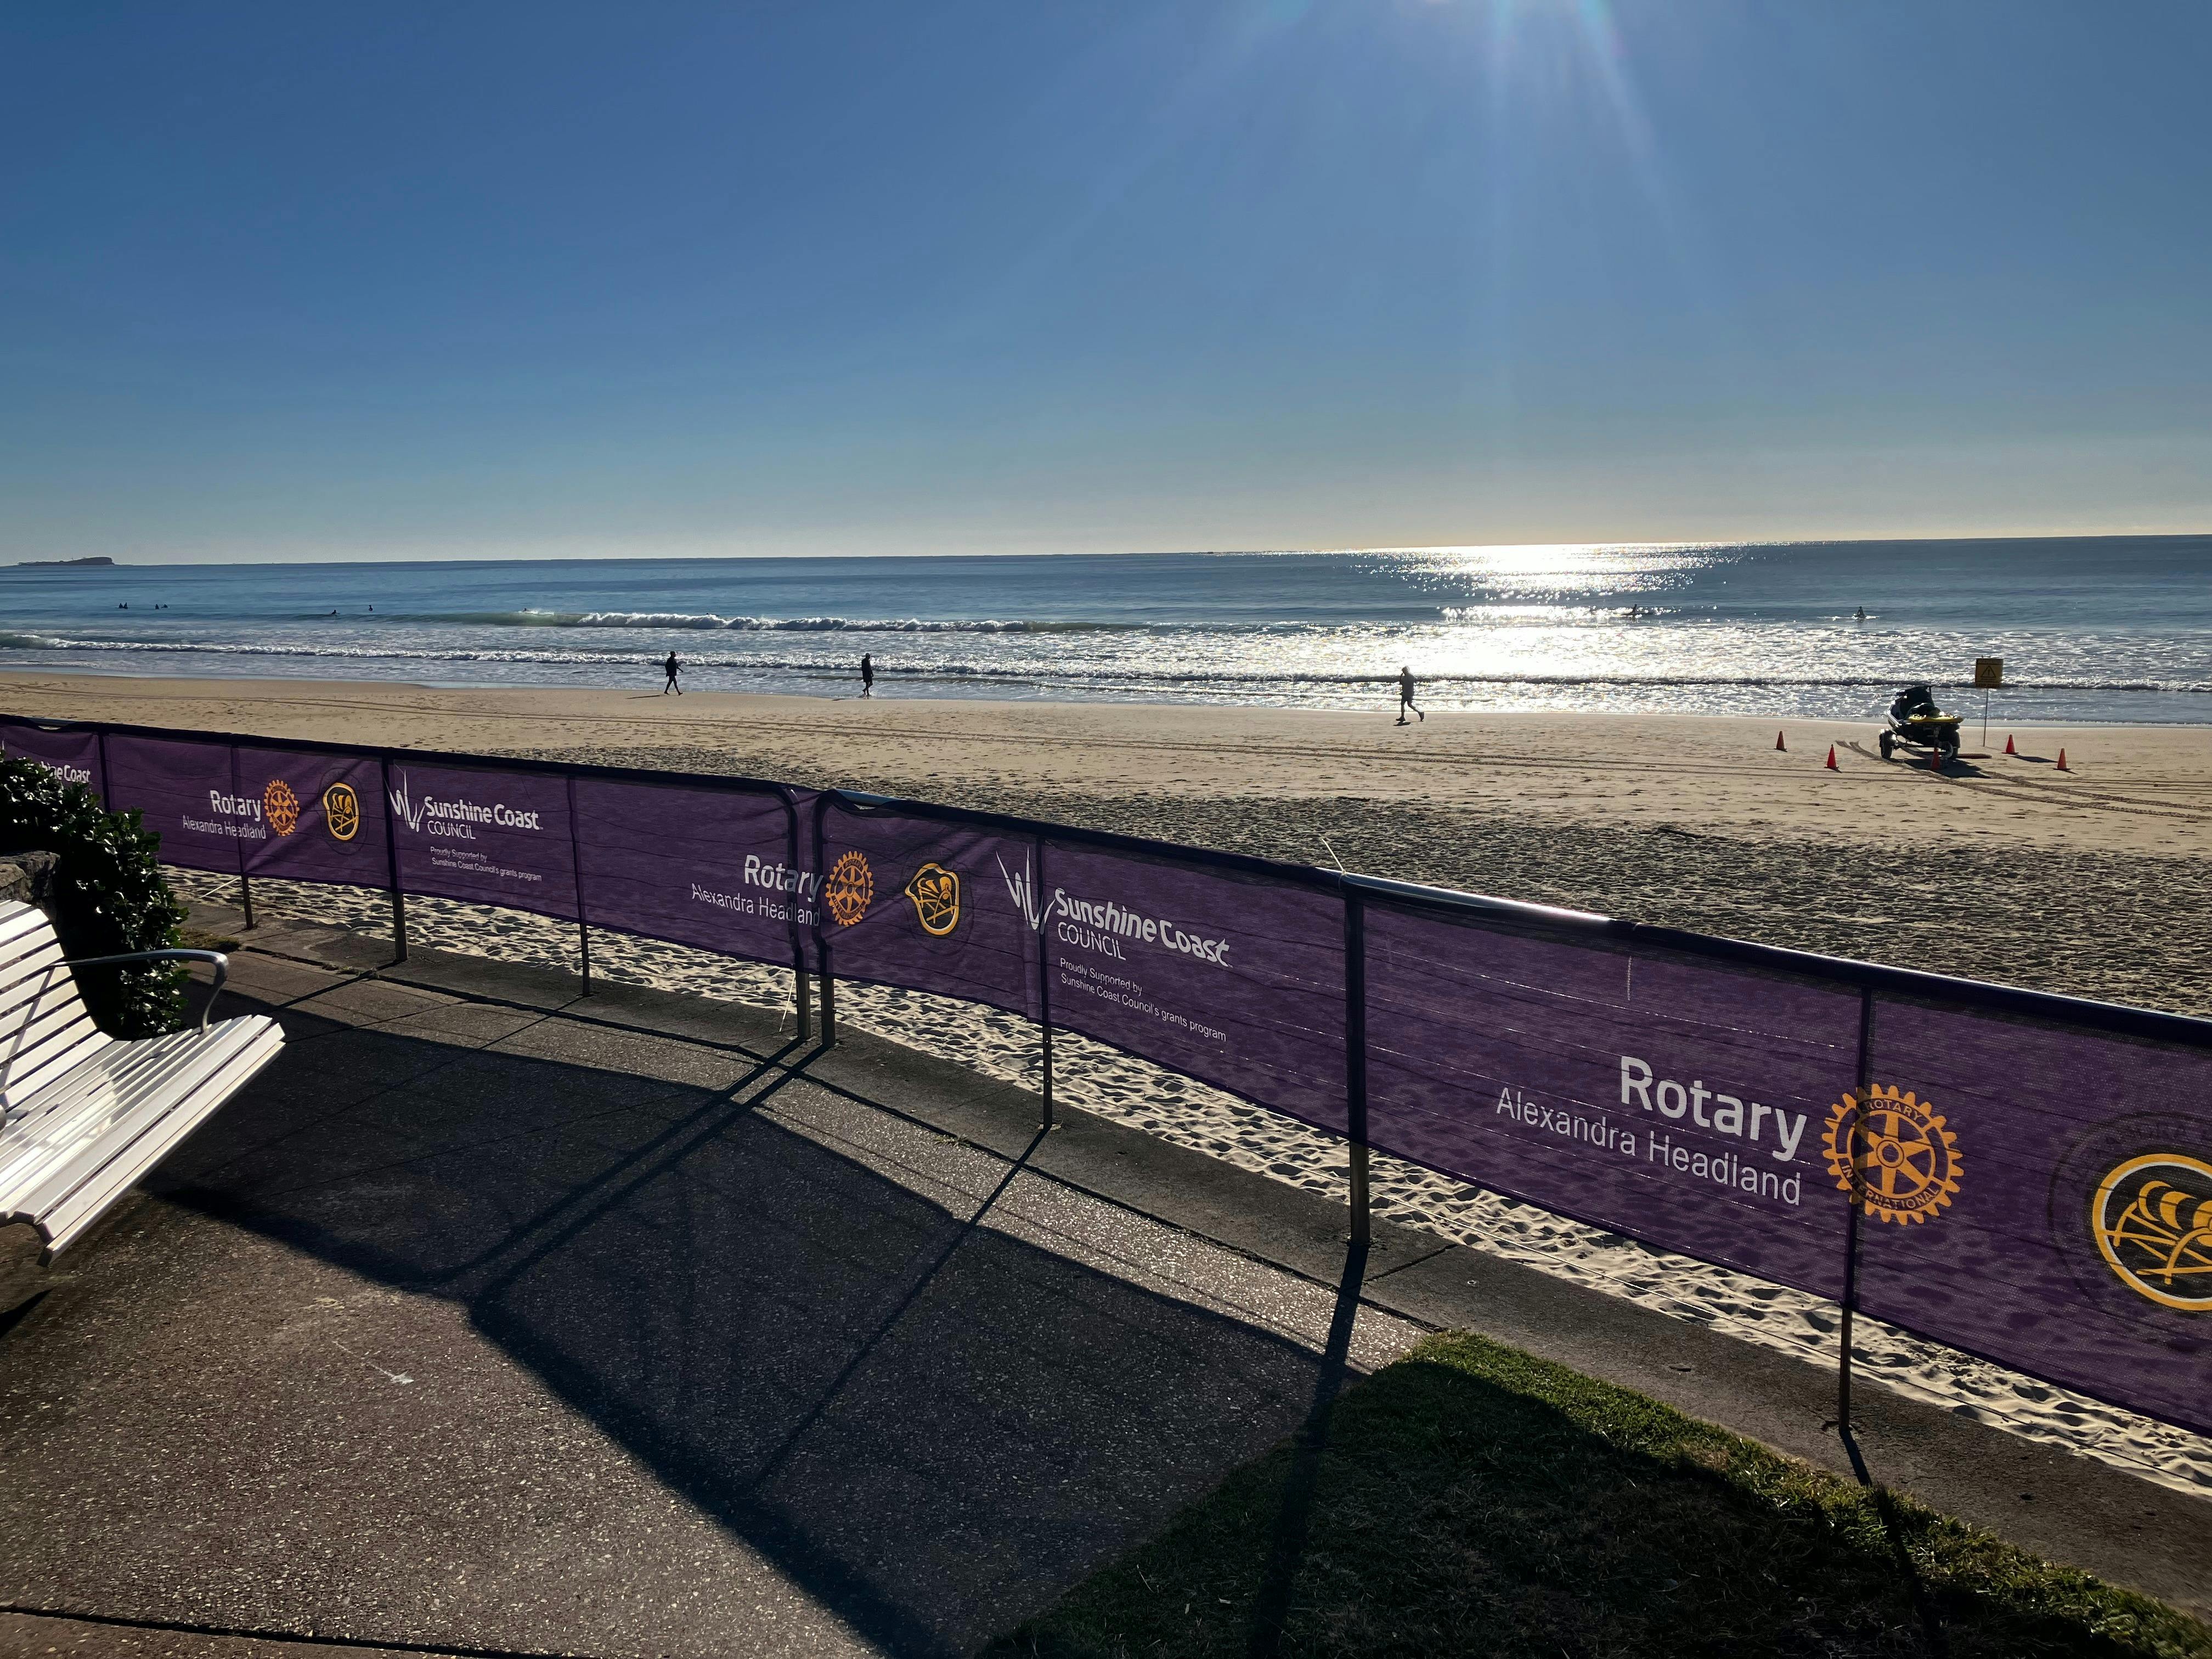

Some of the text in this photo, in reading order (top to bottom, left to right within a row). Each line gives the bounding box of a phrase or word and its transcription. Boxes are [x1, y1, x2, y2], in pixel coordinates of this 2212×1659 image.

[64, 764, 91, 783] Coast
[210, 789, 261, 821] Rotary
[424, 795, 540, 830] Sunshine Coast
[182, 814, 223, 836] Alexandra
[224, 822, 267, 840] Headland
[427, 820, 476, 840] COUNCIL
[430, 846, 488, 863] Proudly Supported by
[432, 857, 542, 882] Sunshine Coast Council's grants program
[744, 854, 823, 902] Rotary
[692, 883, 821, 927] Alexandra Headland
[1054, 887, 1231, 968] Sunshine Coast
[1057, 921, 1126, 961] COUNCIL
[1060, 957, 1143, 996] Proudly Supported by
[1061, 973, 1227, 1042] Sunshine Coast Council's grants program
[1620, 1056, 1807, 1162] Rotary
[1866, 1099, 1923, 1121] ROTARY
[1496, 1086, 1801, 1206] Alexandra Headland
